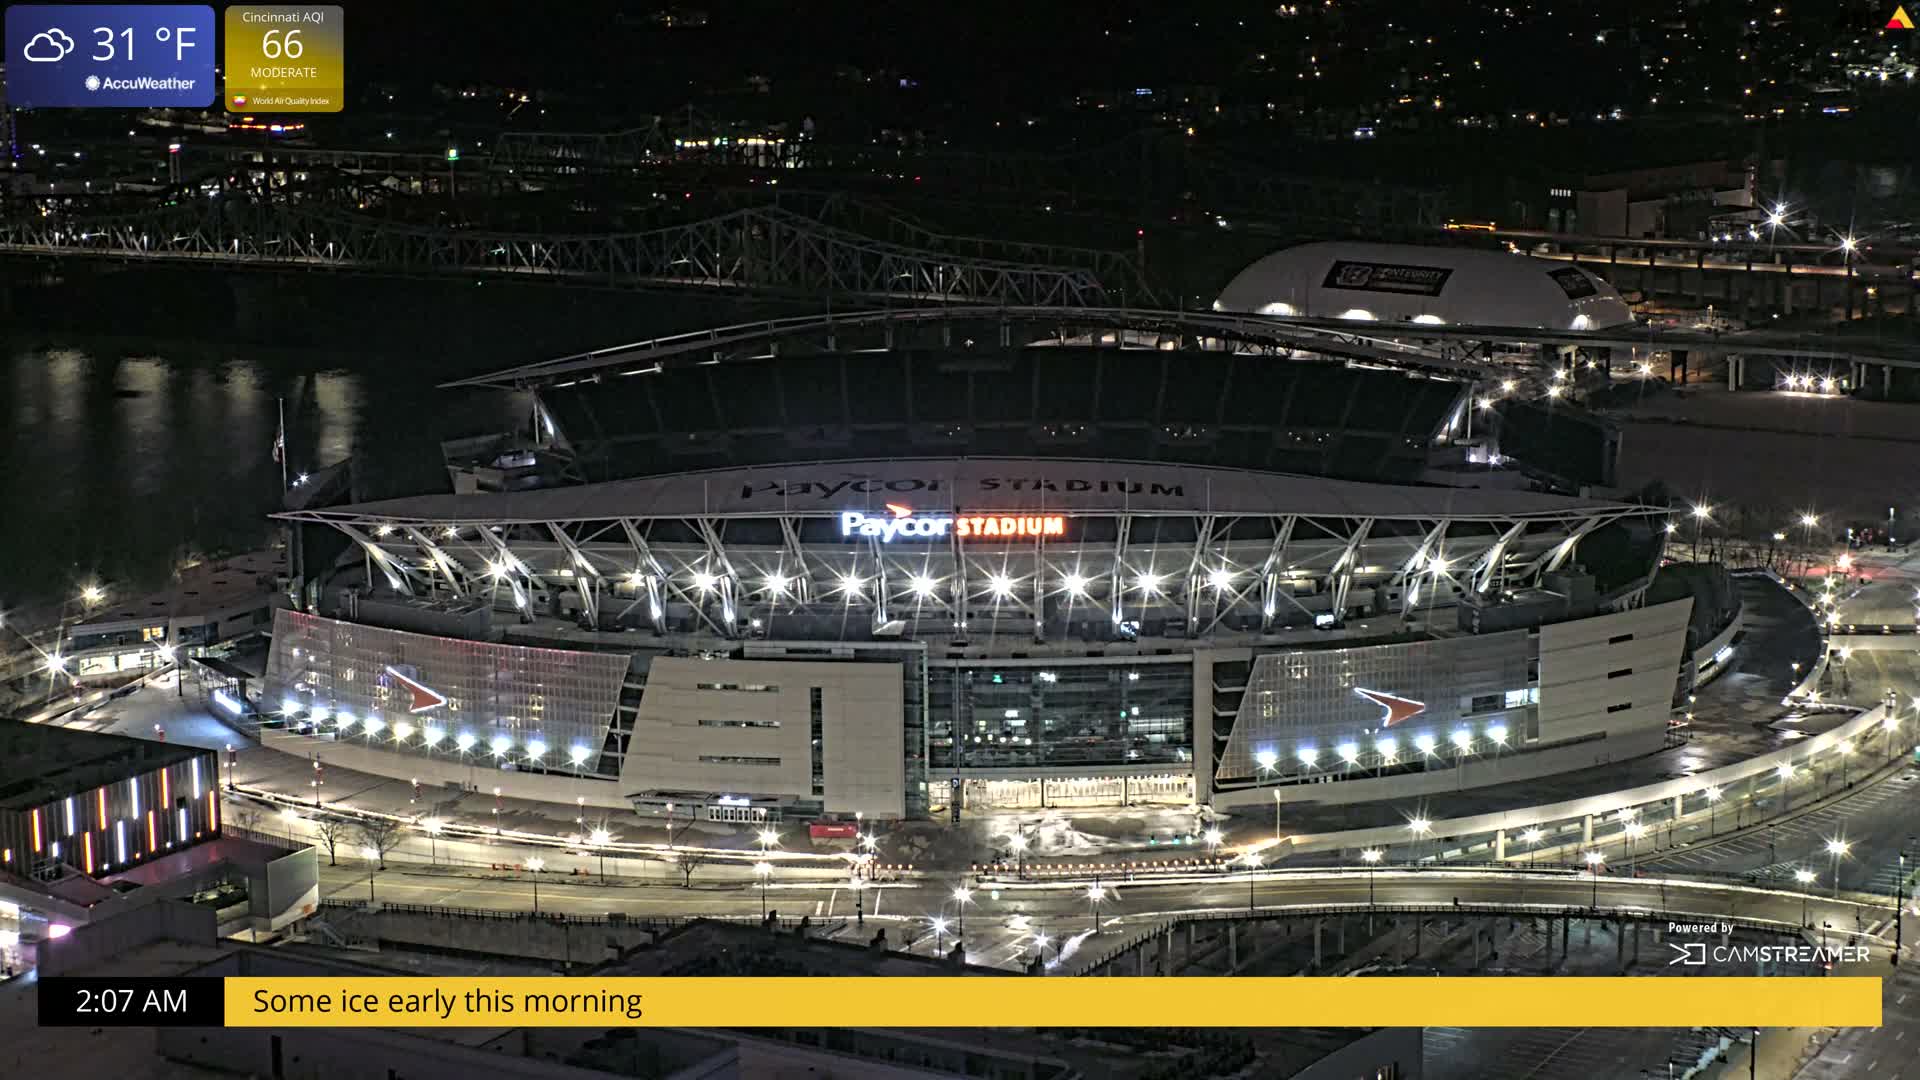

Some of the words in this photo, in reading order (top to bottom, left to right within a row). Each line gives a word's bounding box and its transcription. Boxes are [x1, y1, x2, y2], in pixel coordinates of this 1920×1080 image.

[979, 478, 1184, 497] STADIUM
[841, 511, 954, 543] Paycor
[956, 516, 1065, 537] STADIUM
